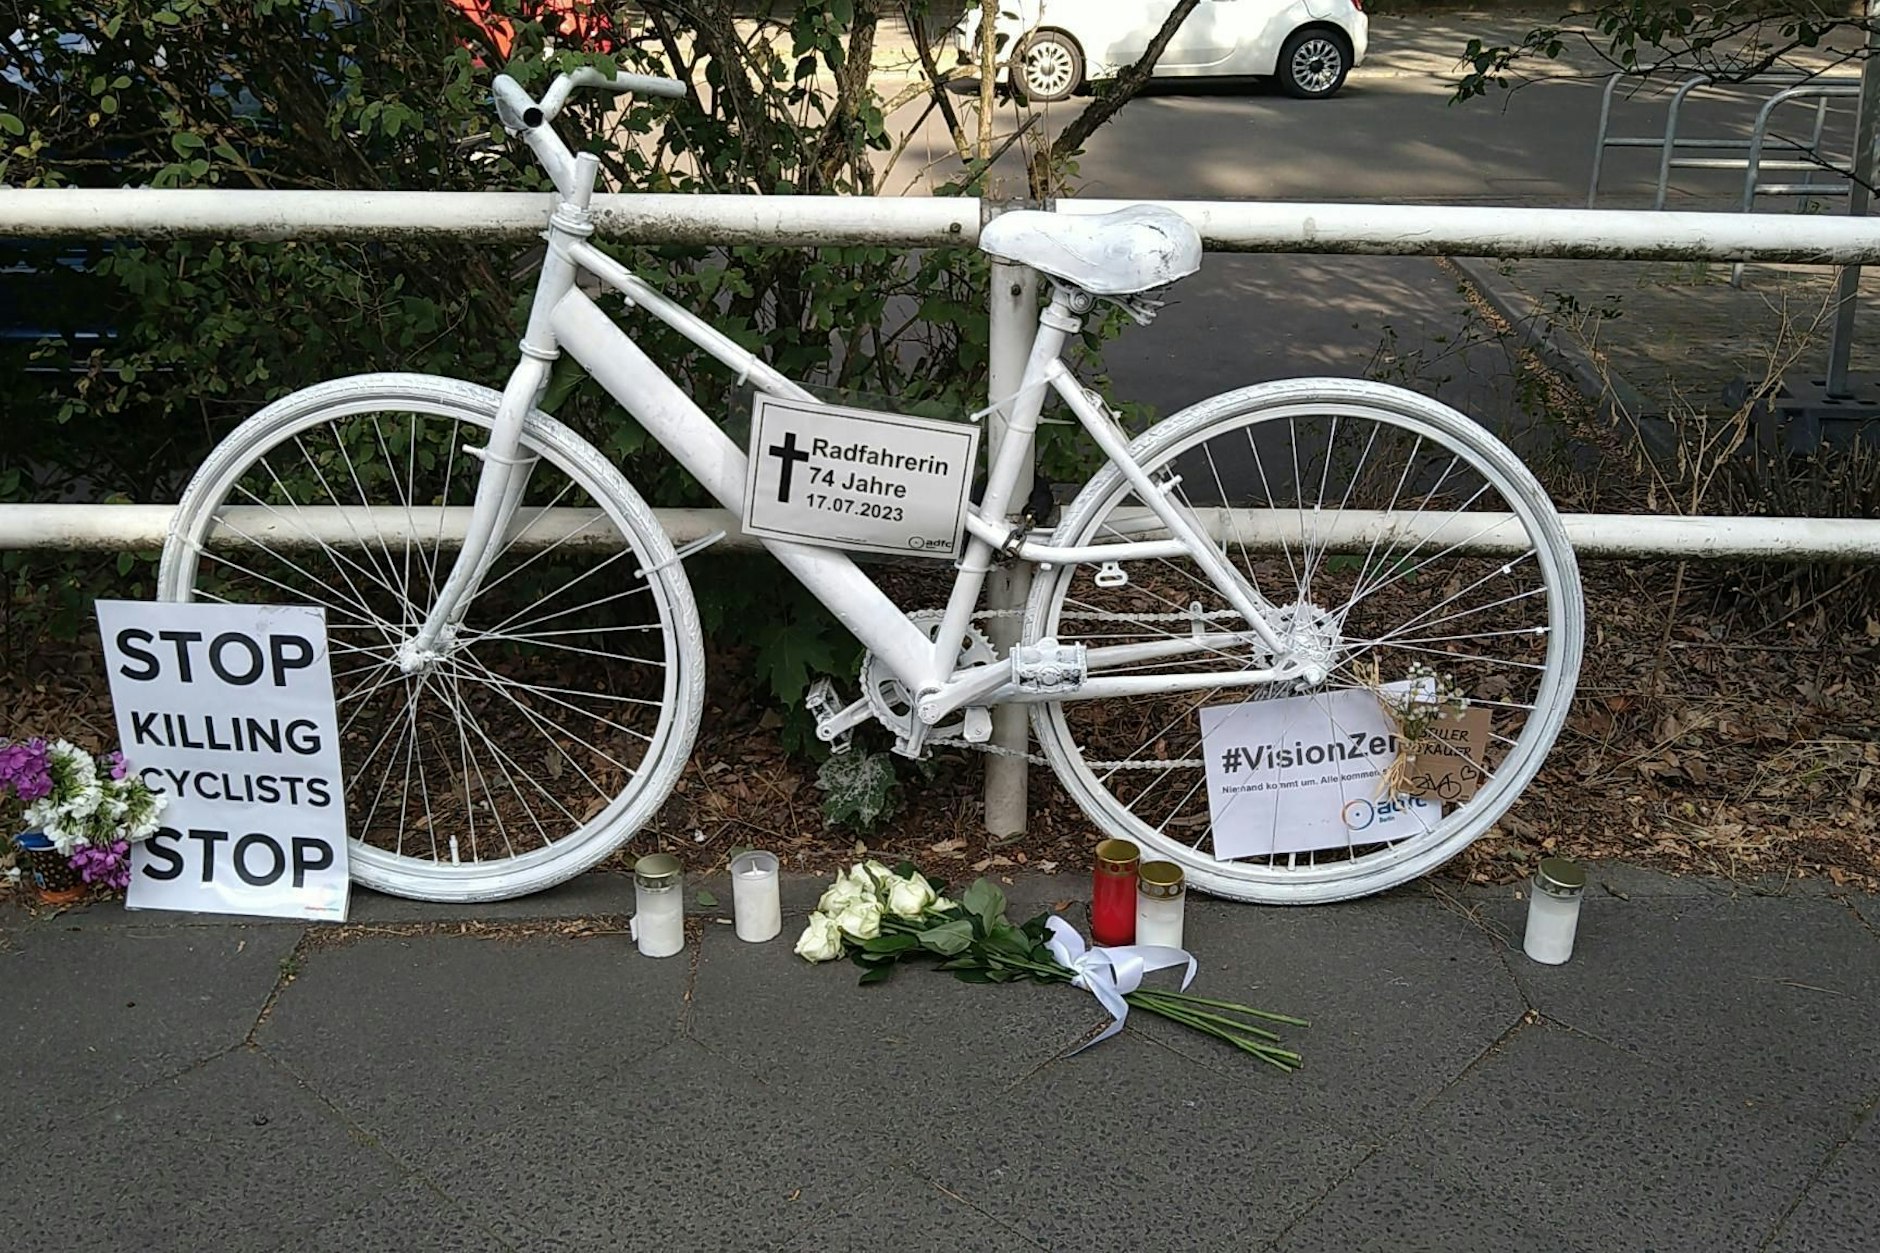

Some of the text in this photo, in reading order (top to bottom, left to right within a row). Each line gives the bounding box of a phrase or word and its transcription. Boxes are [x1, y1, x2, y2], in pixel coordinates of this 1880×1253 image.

[812, 438, 949, 476] Radfahrerin
[809, 466, 907, 498] 74 Jahre
[806, 493, 904, 522] 17.07.2023
[116, 628, 314, 687] STOP
[131, 711, 322, 755] KILLING
[1221, 731, 1398, 774] #VisionZer
[139, 767, 331, 807] CYCLISTS
[1222, 782, 1264, 794] Niemand
[1266, 780, 1299, 790] kommt
[1320, 775, 1339, 785] Alle
[1341, 770, 1379, 781] kommen
[142, 827, 334, 888] STOP
